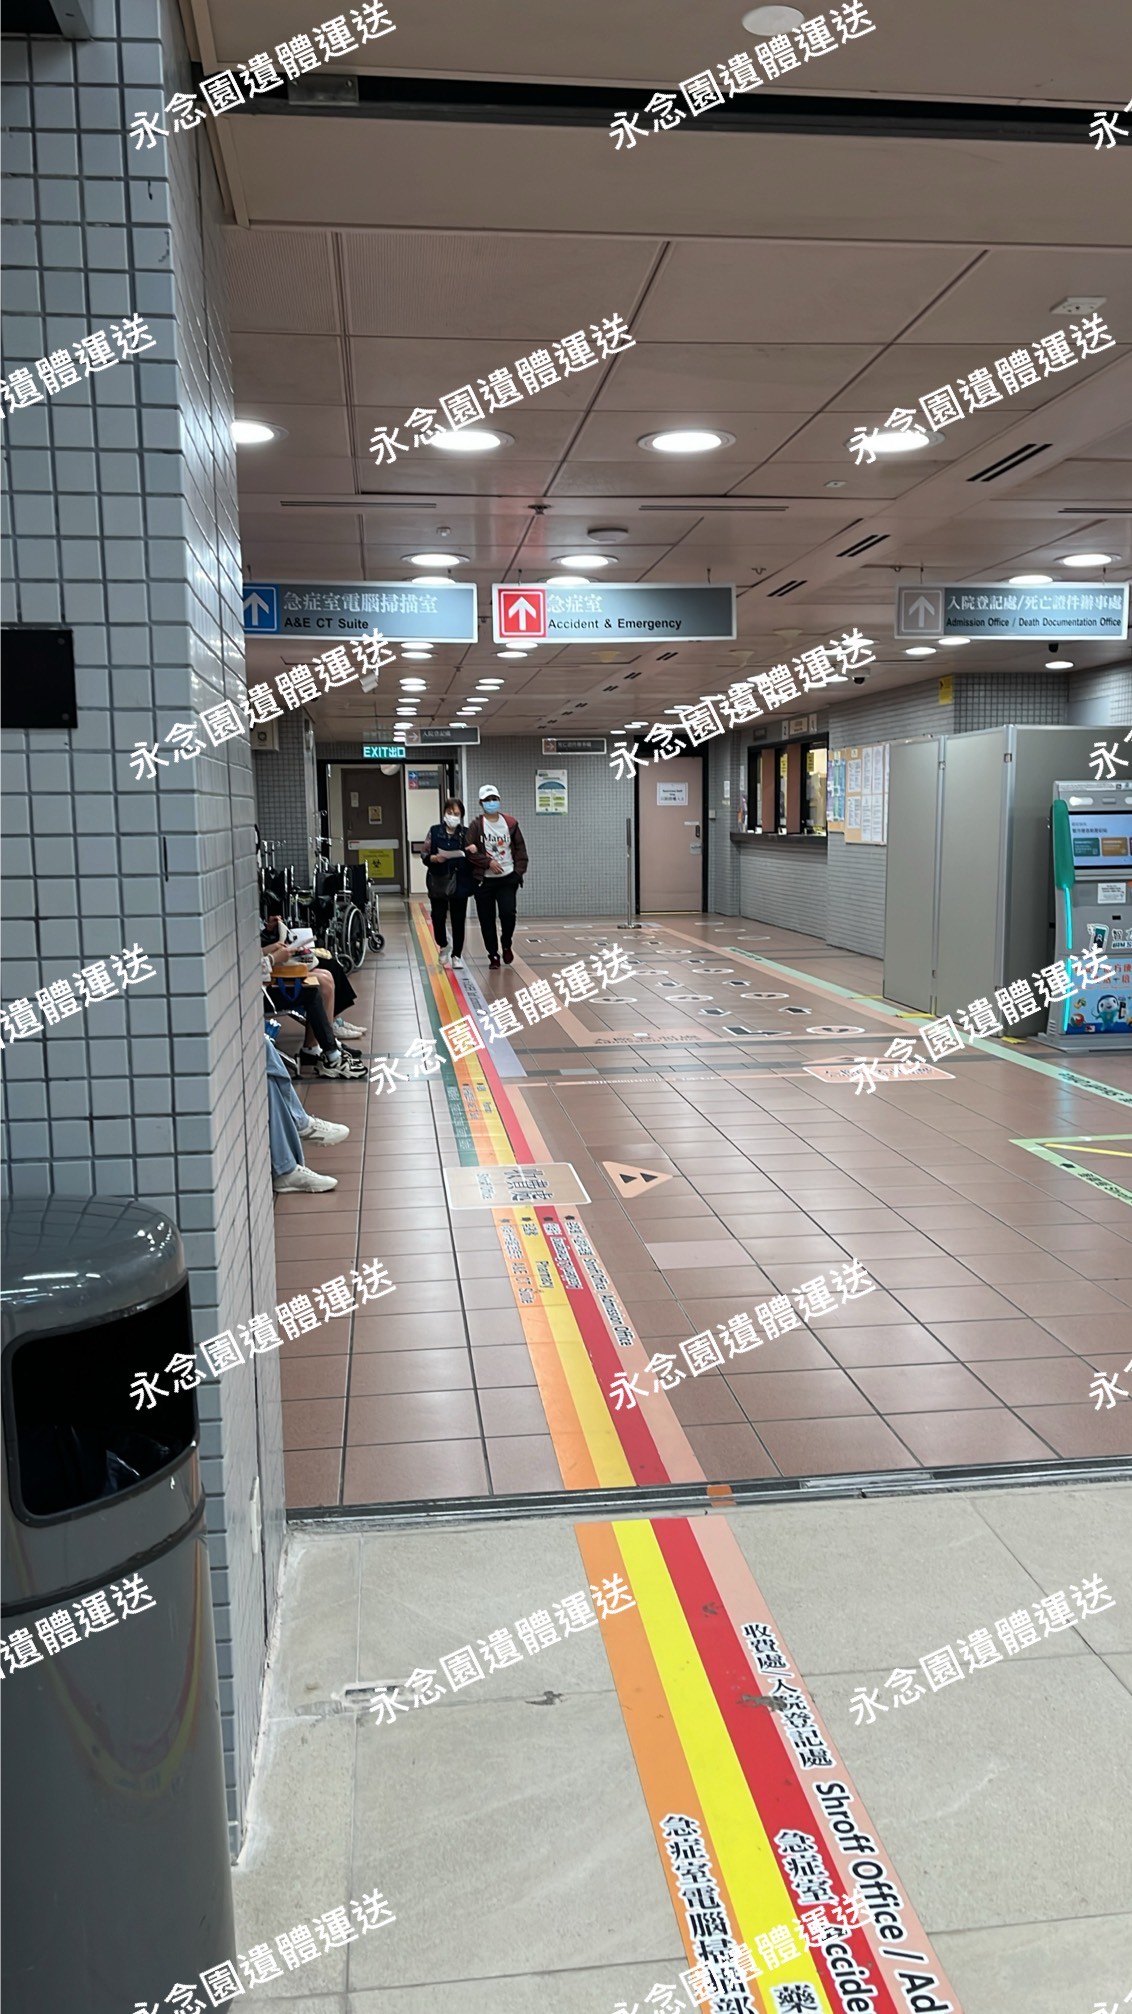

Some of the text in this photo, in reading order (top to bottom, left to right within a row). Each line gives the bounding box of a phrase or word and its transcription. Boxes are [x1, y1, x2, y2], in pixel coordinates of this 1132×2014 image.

[283, 591, 438, 614] 急症室電腦掃描室
[547, 593, 603, 613] 急症室
[946, 594, 1122, 611] 入院登記處/死亡證件辦事處
[284, 617, 369, 629] A&E CT Suite
[548, 618, 682, 631] Accident & Emergency
[946, 617, 1122, 627] Admission Office / Death Documentation Office
[363, 746, 406, 758] EXIT 出口
[536, 1260, 555, 1288] Pharmacy
[601, 1294, 625, 1326] Admission
[613, 1326, 634, 1346] Office
[743, 1624, 833, 1768] 收費處/入院登記處
[778, 1831, 835, 1902] 急症室
[816, 1782, 949, 2014] Shroff Office / Ad
